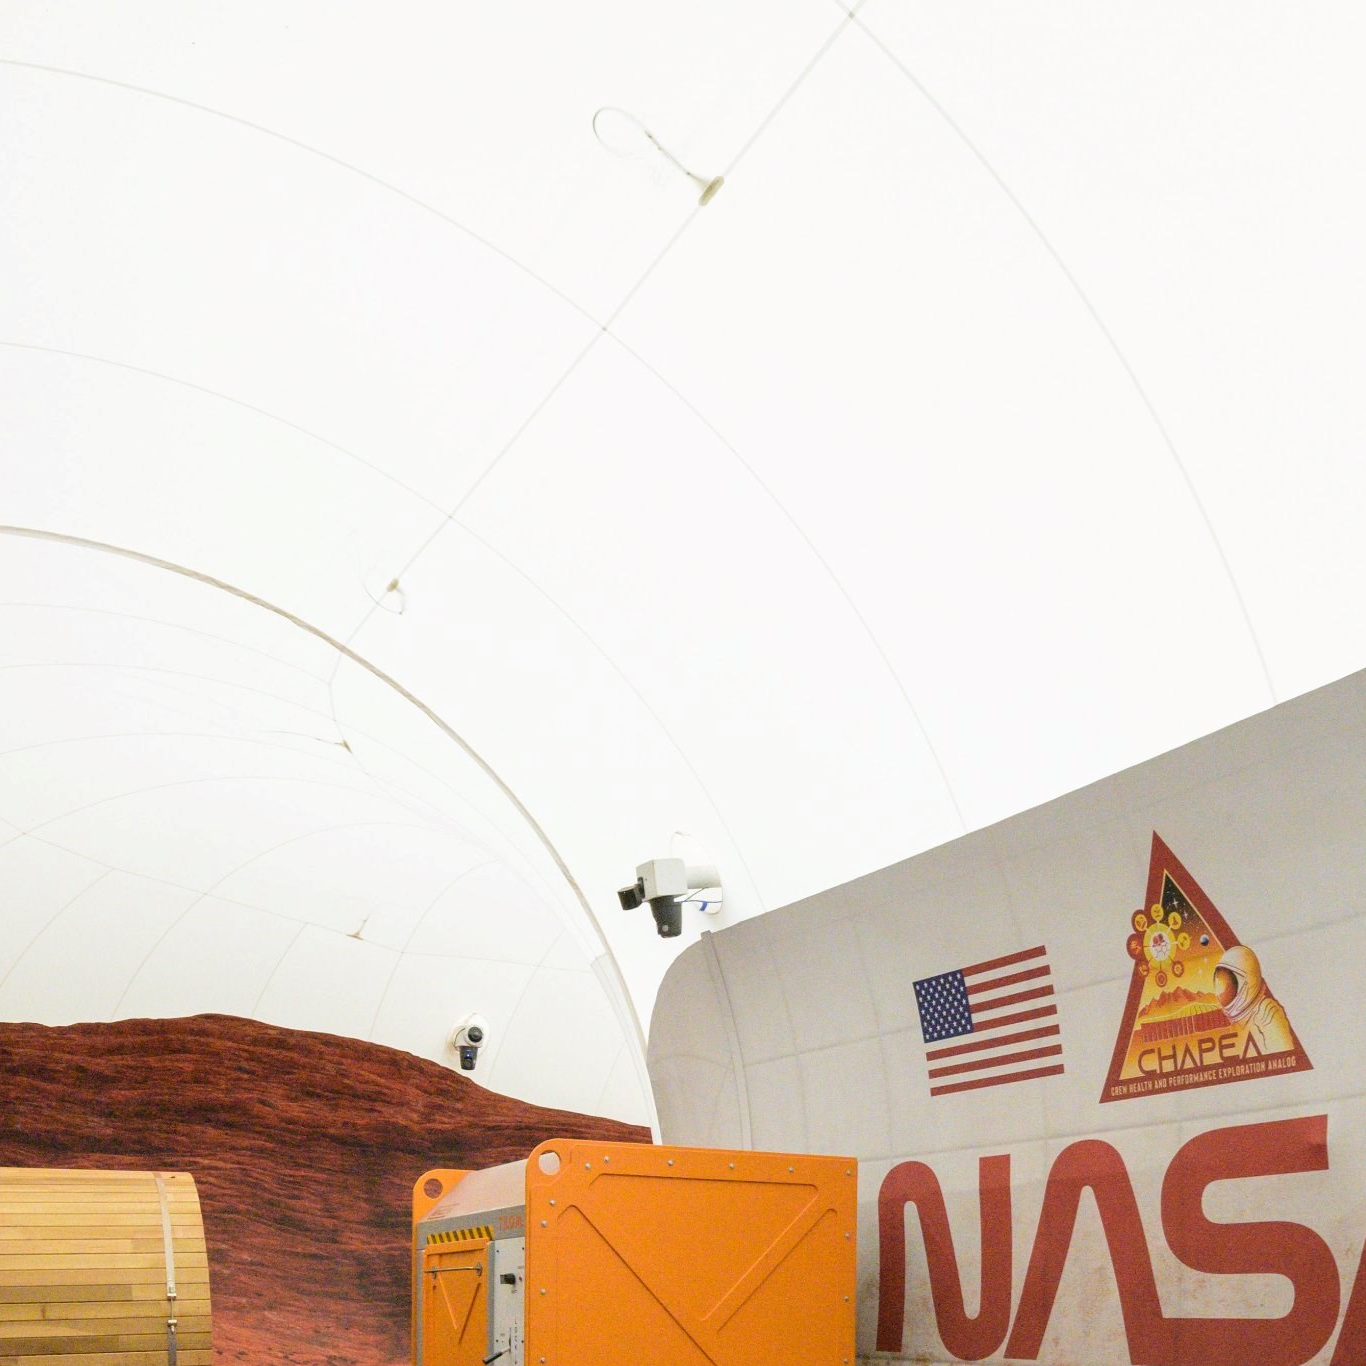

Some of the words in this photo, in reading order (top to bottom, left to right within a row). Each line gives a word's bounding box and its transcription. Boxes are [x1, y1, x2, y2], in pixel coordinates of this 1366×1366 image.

[1137, 1031, 1262, 1076] CHAPEA
[1110, 1085, 1127, 1096] CREW
[1129, 1080, 1153, 1093] HEALTH
[1154, 1078, 1167, 1089] AND
[1168, 1069, 1217, 1087] PERFORMANCE
[1218, 1061, 1266, 1079] EXPLORATION
[1267, 1055, 1297, 1070] ANALOG
